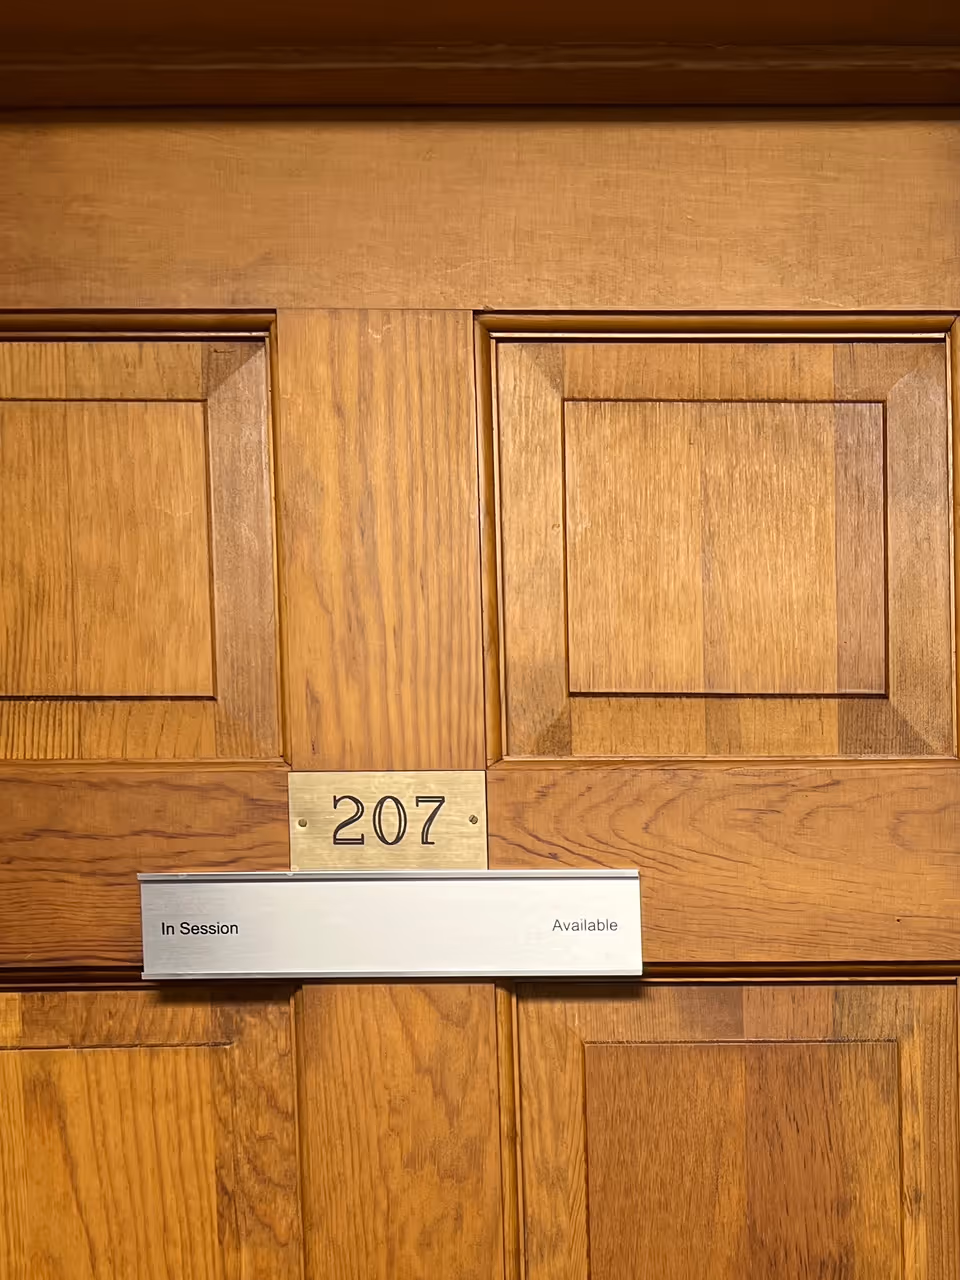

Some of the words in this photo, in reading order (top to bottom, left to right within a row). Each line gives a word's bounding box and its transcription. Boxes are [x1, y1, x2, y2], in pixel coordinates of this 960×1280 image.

[332, 795, 446, 846] 207
[161, 921, 175, 936] In
[179, 921, 239, 936] Session
[552, 918, 619, 933] Available
